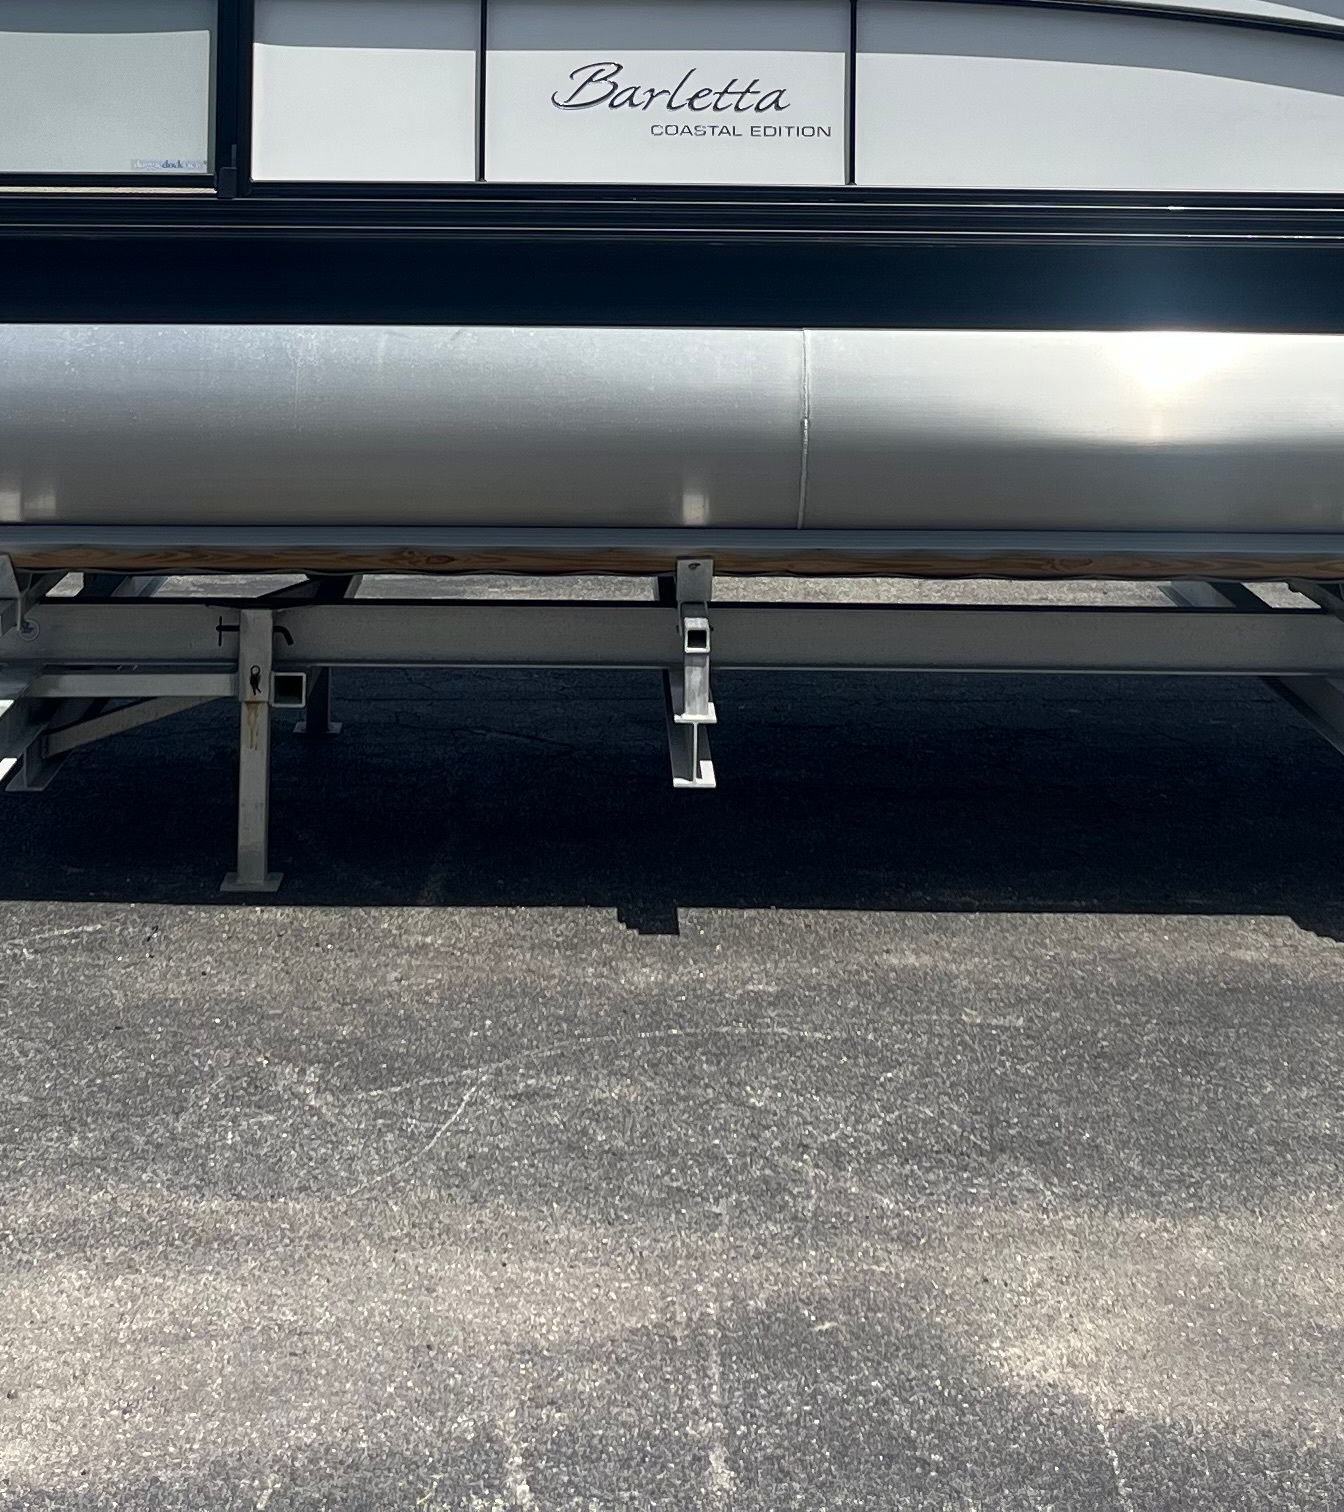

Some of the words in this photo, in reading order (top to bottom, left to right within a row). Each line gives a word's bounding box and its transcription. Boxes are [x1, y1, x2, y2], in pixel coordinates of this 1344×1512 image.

[551, 61, 791, 114] Barletta
[650, 124, 743, 137] COASTAL
[749, 125, 832, 138] EDITION
